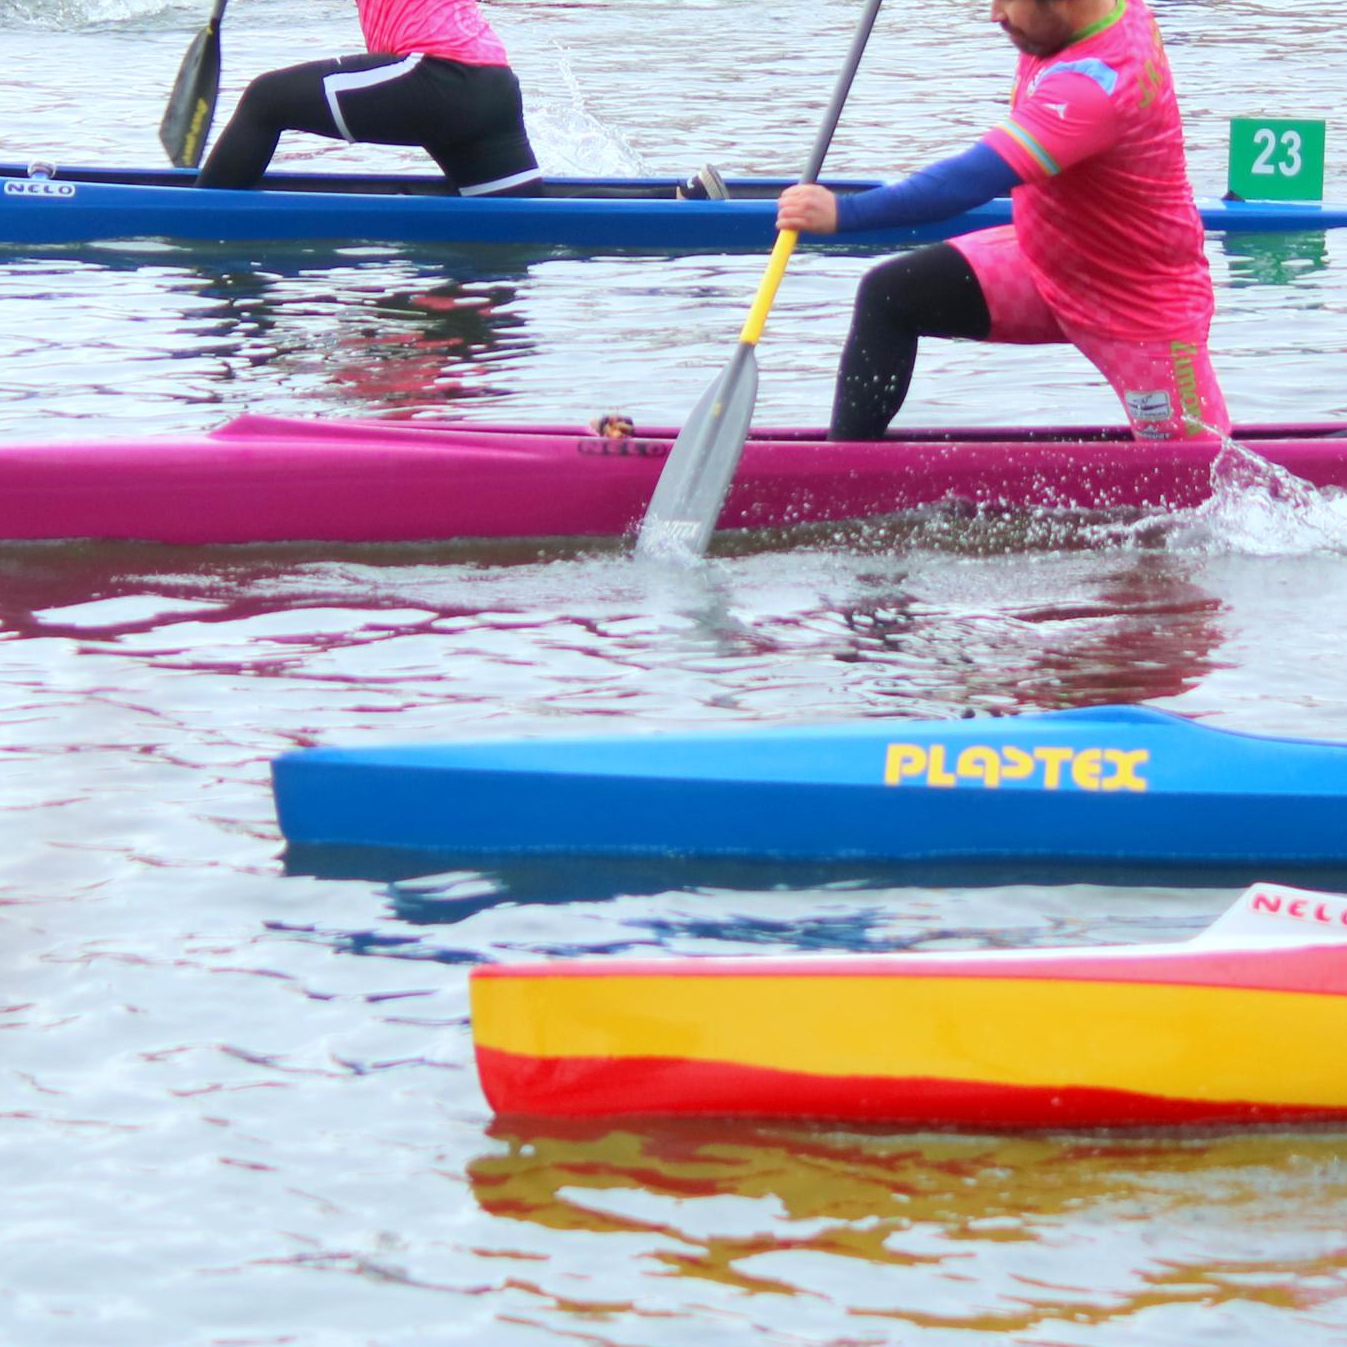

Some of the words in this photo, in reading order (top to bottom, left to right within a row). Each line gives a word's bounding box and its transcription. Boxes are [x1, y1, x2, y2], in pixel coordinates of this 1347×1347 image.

[1251, 128, 1301, 177] 23
[7, 183, 73, 195] NELO
[884, 742, 1150, 793] PLASTEX
